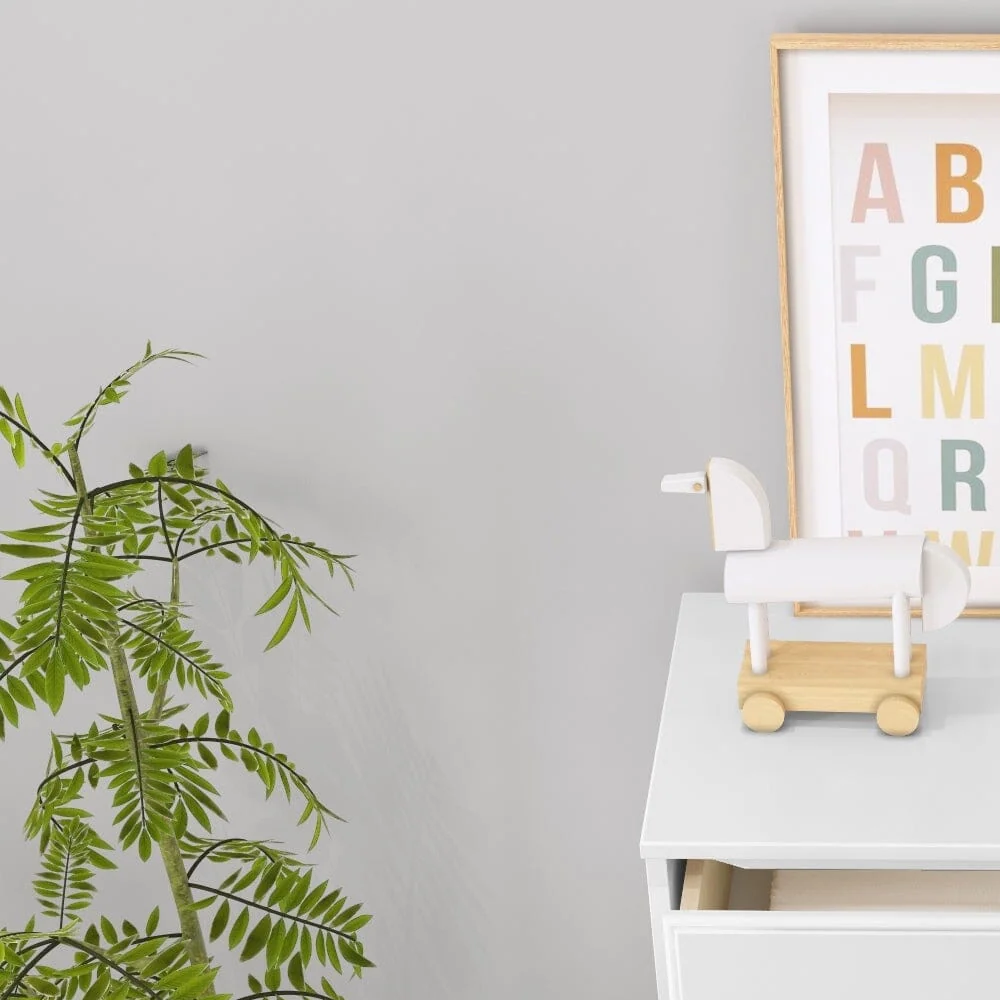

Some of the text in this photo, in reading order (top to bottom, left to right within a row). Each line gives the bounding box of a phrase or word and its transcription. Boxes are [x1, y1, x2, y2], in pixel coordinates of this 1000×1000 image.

[851, 142, 905, 224] A
[934, 142, 985, 224] B
[840, 244, 881, 324] F
[911, 244, 958, 324] G
[850, 343, 892, 419] L
[920, 344, 986, 420] M
[862, 439, 912, 515] Q
[941, 439, 987, 512] R
